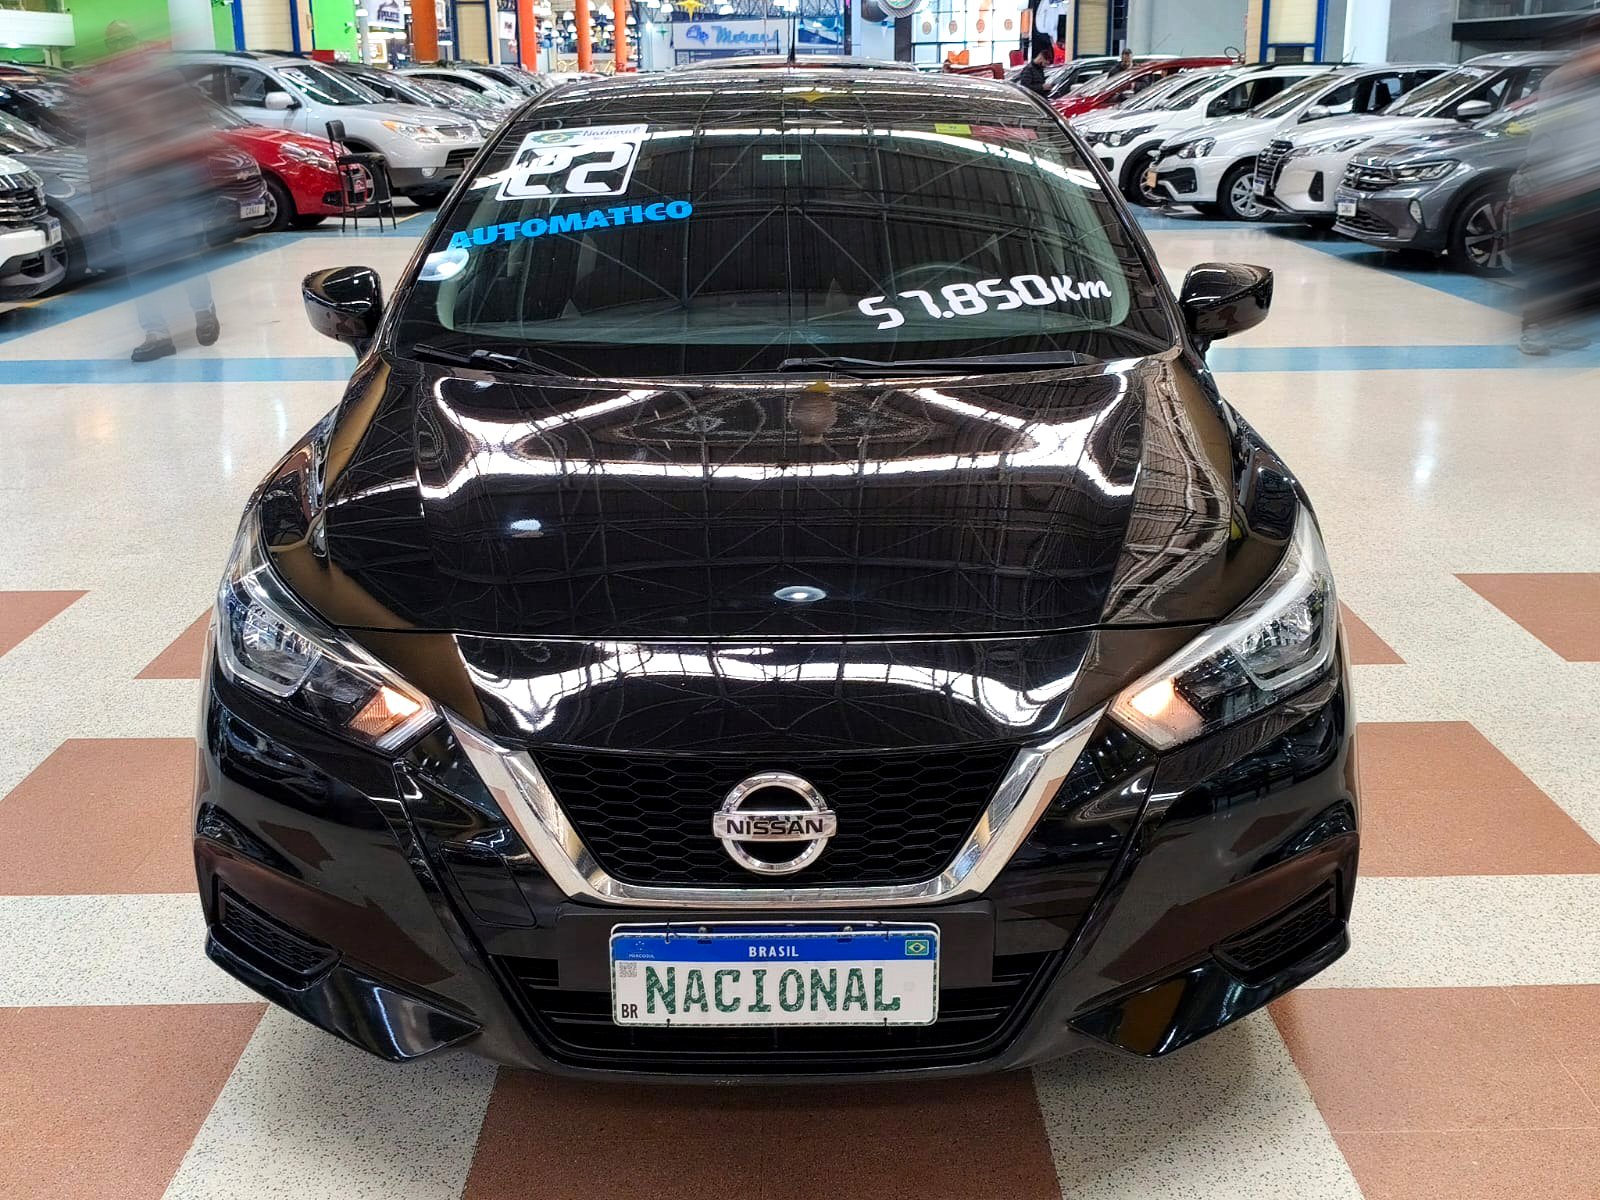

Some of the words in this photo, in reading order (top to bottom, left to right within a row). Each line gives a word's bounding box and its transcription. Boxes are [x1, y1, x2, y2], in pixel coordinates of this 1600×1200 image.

[505, 143, 634, 195] 22
[447, 200, 693, 249] AUTOMATICO
[726, 819, 823, 835] NISSAN
[748, 945, 799, 957] BRASIL
[645, 966, 901, 1014] NACIONAL
[621, 1004, 638, 1018] BR
